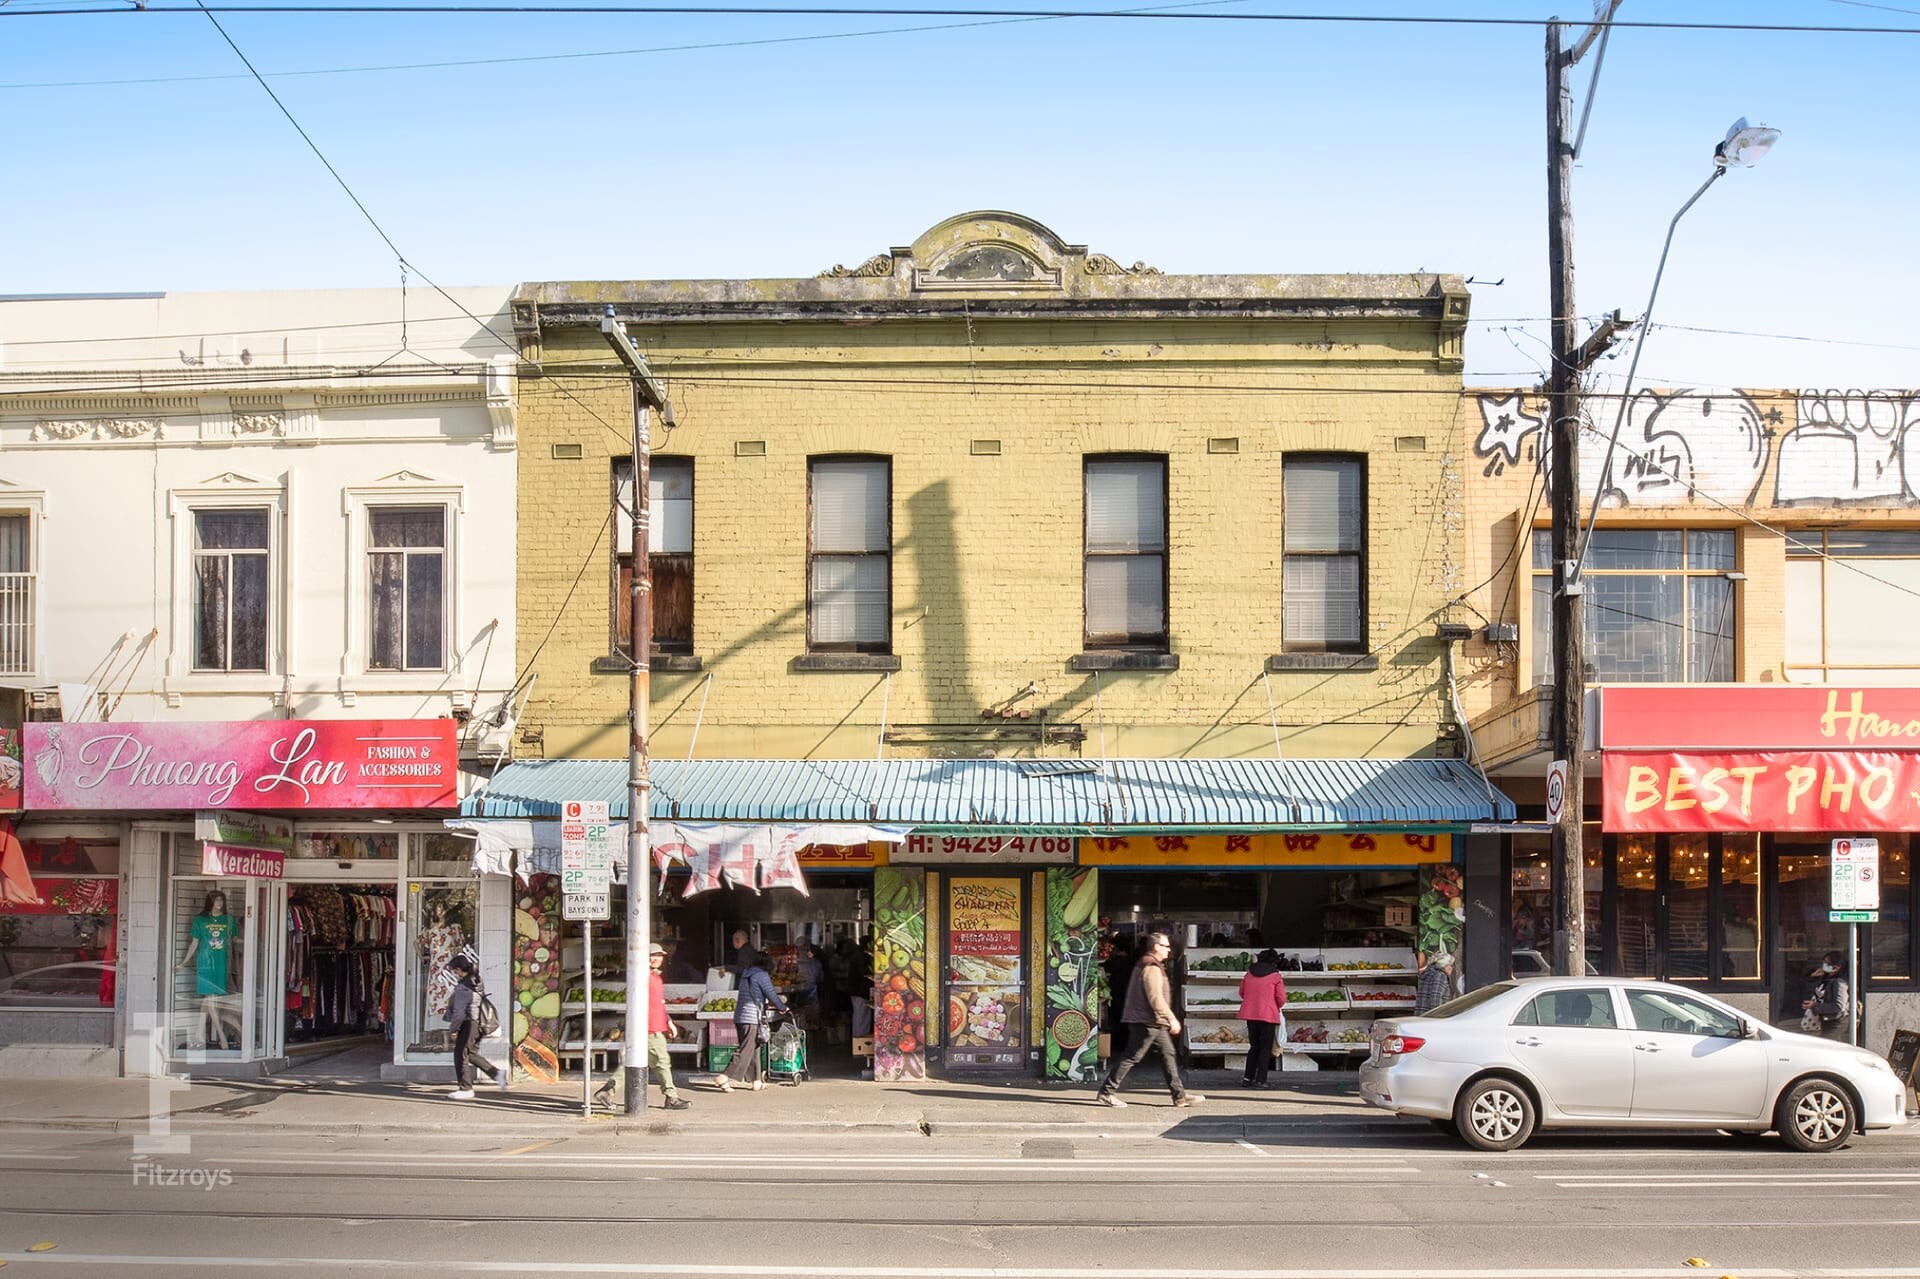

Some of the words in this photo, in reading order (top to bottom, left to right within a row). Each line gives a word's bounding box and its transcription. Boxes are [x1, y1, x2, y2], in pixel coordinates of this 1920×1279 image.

[367, 746, 417, 760] FASHION
[421, 746, 431, 758] &
[75, 733, 244, 805] Phuong
[254, 728, 348, 804] Lan
[358, 763, 442, 777] ACCESSORIES
[1550, 782, 1560, 803] 40
[1624, 765, 1768, 816] BEST
[1785, 765, 1896, 815] PHO
[588, 826, 606, 837] 2P
[942, 836, 1001, 853] 9429
[1011, 836, 1071, 853] 4768
[208, 847, 281, 877] Alterations
[1835, 864, 1853, 875] 2P
[565, 871, 583, 882] 2P
